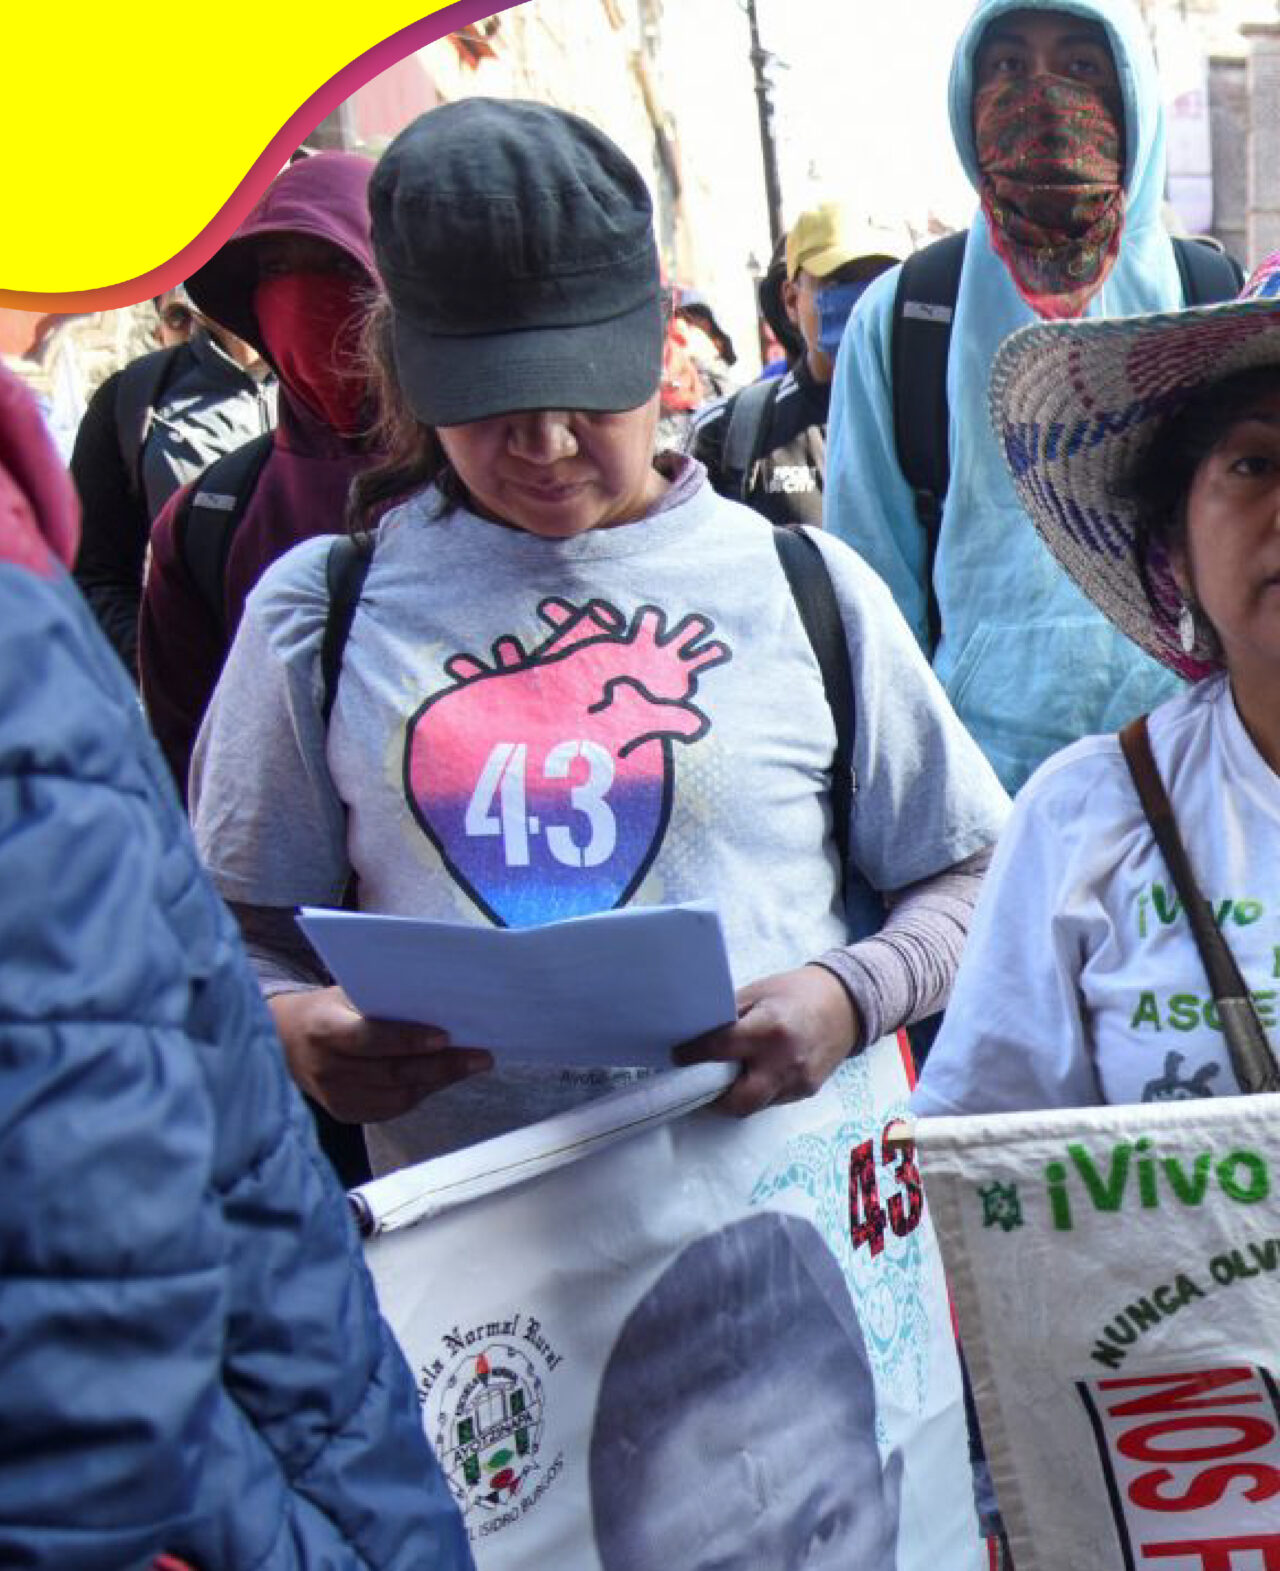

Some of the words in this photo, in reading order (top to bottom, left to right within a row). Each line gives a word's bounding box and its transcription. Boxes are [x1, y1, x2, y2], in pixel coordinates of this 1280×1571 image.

[465, 738, 616, 868] 43
[849, 1118, 924, 1260] 43
[1046, 1137, 1269, 1231] ¡Vivo
[1090, 1273, 1206, 1370] NUNCA
